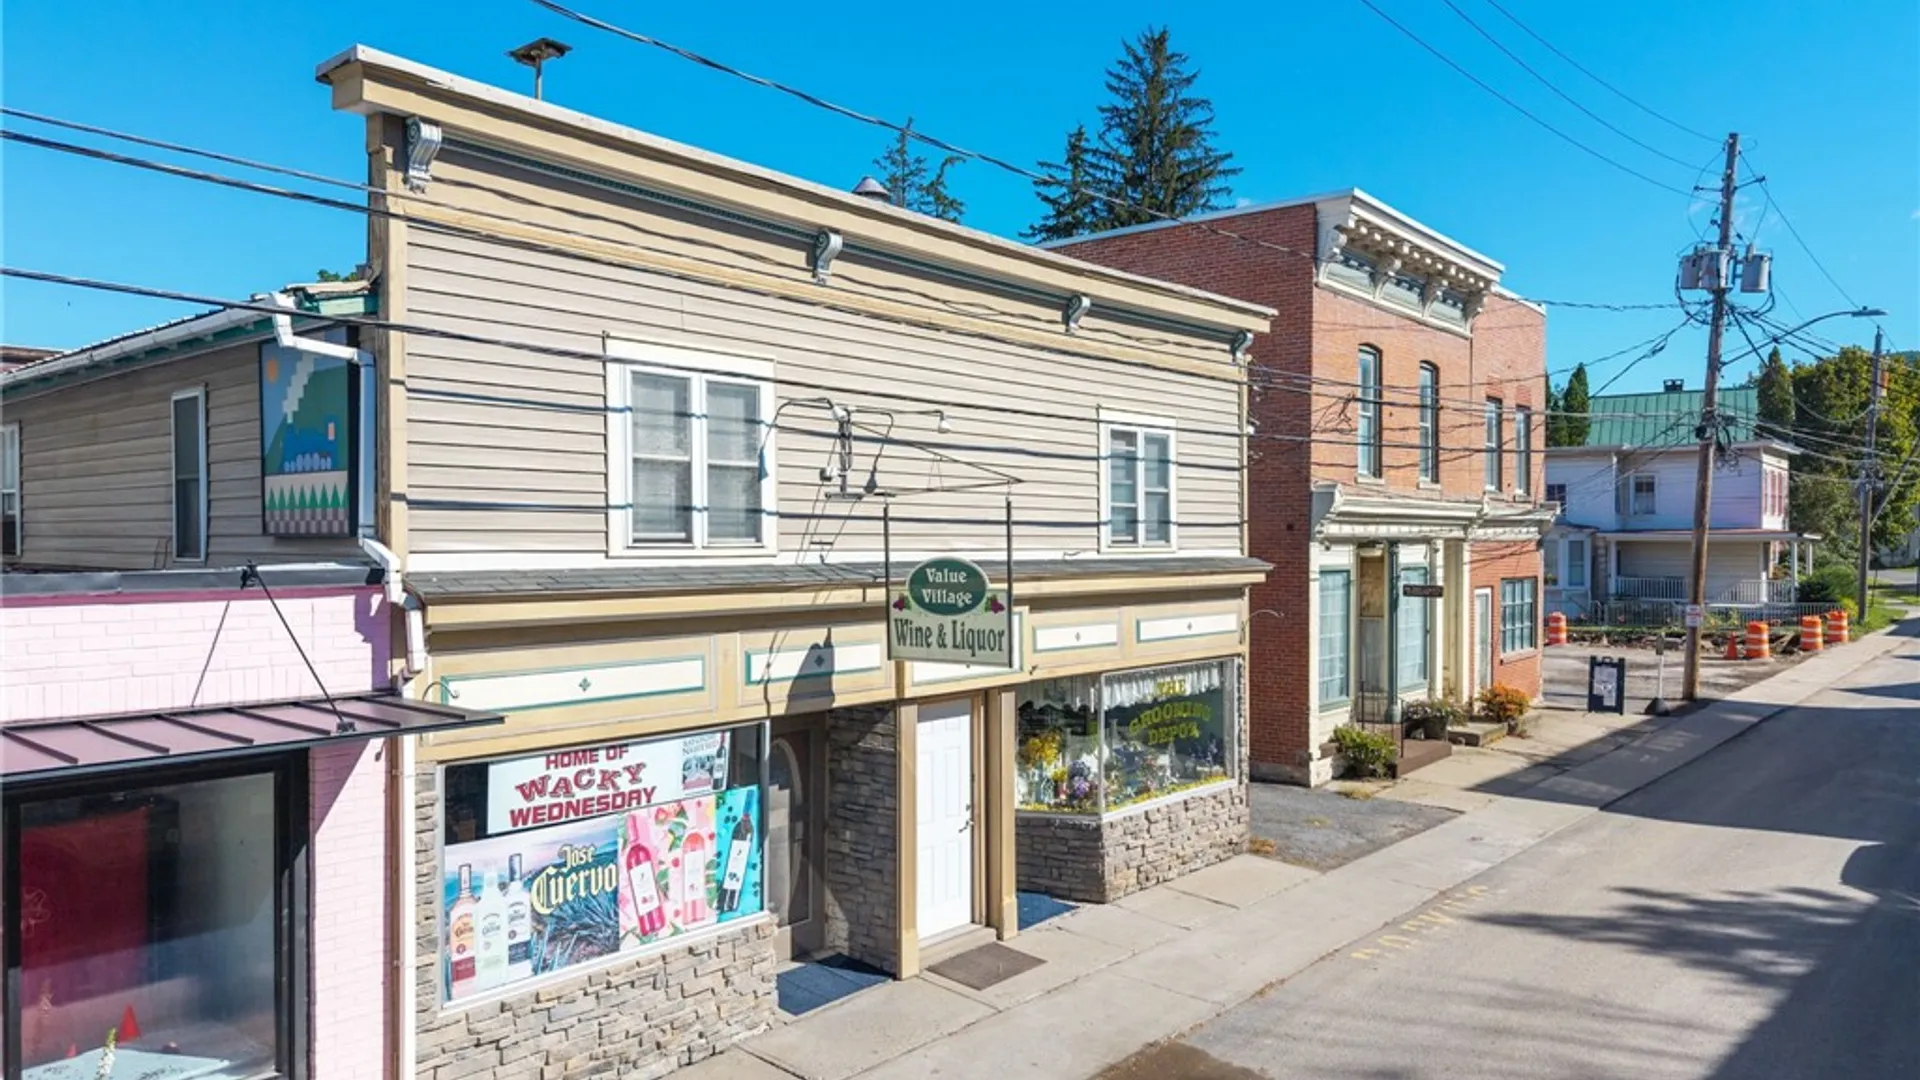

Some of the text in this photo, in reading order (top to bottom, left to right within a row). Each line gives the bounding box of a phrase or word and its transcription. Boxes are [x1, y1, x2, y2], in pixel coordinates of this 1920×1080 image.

[926, 567, 968, 584] Value
[921, 588, 973, 609] Village
[893, 618, 1006, 658] Wine & Liquor
[545, 744, 630, 771] HOME OF
[515, 761, 647, 803] WACKY
[509, 785, 657, 828] WEDNESDAY
[530, 864, 618, 915] Cuervo
